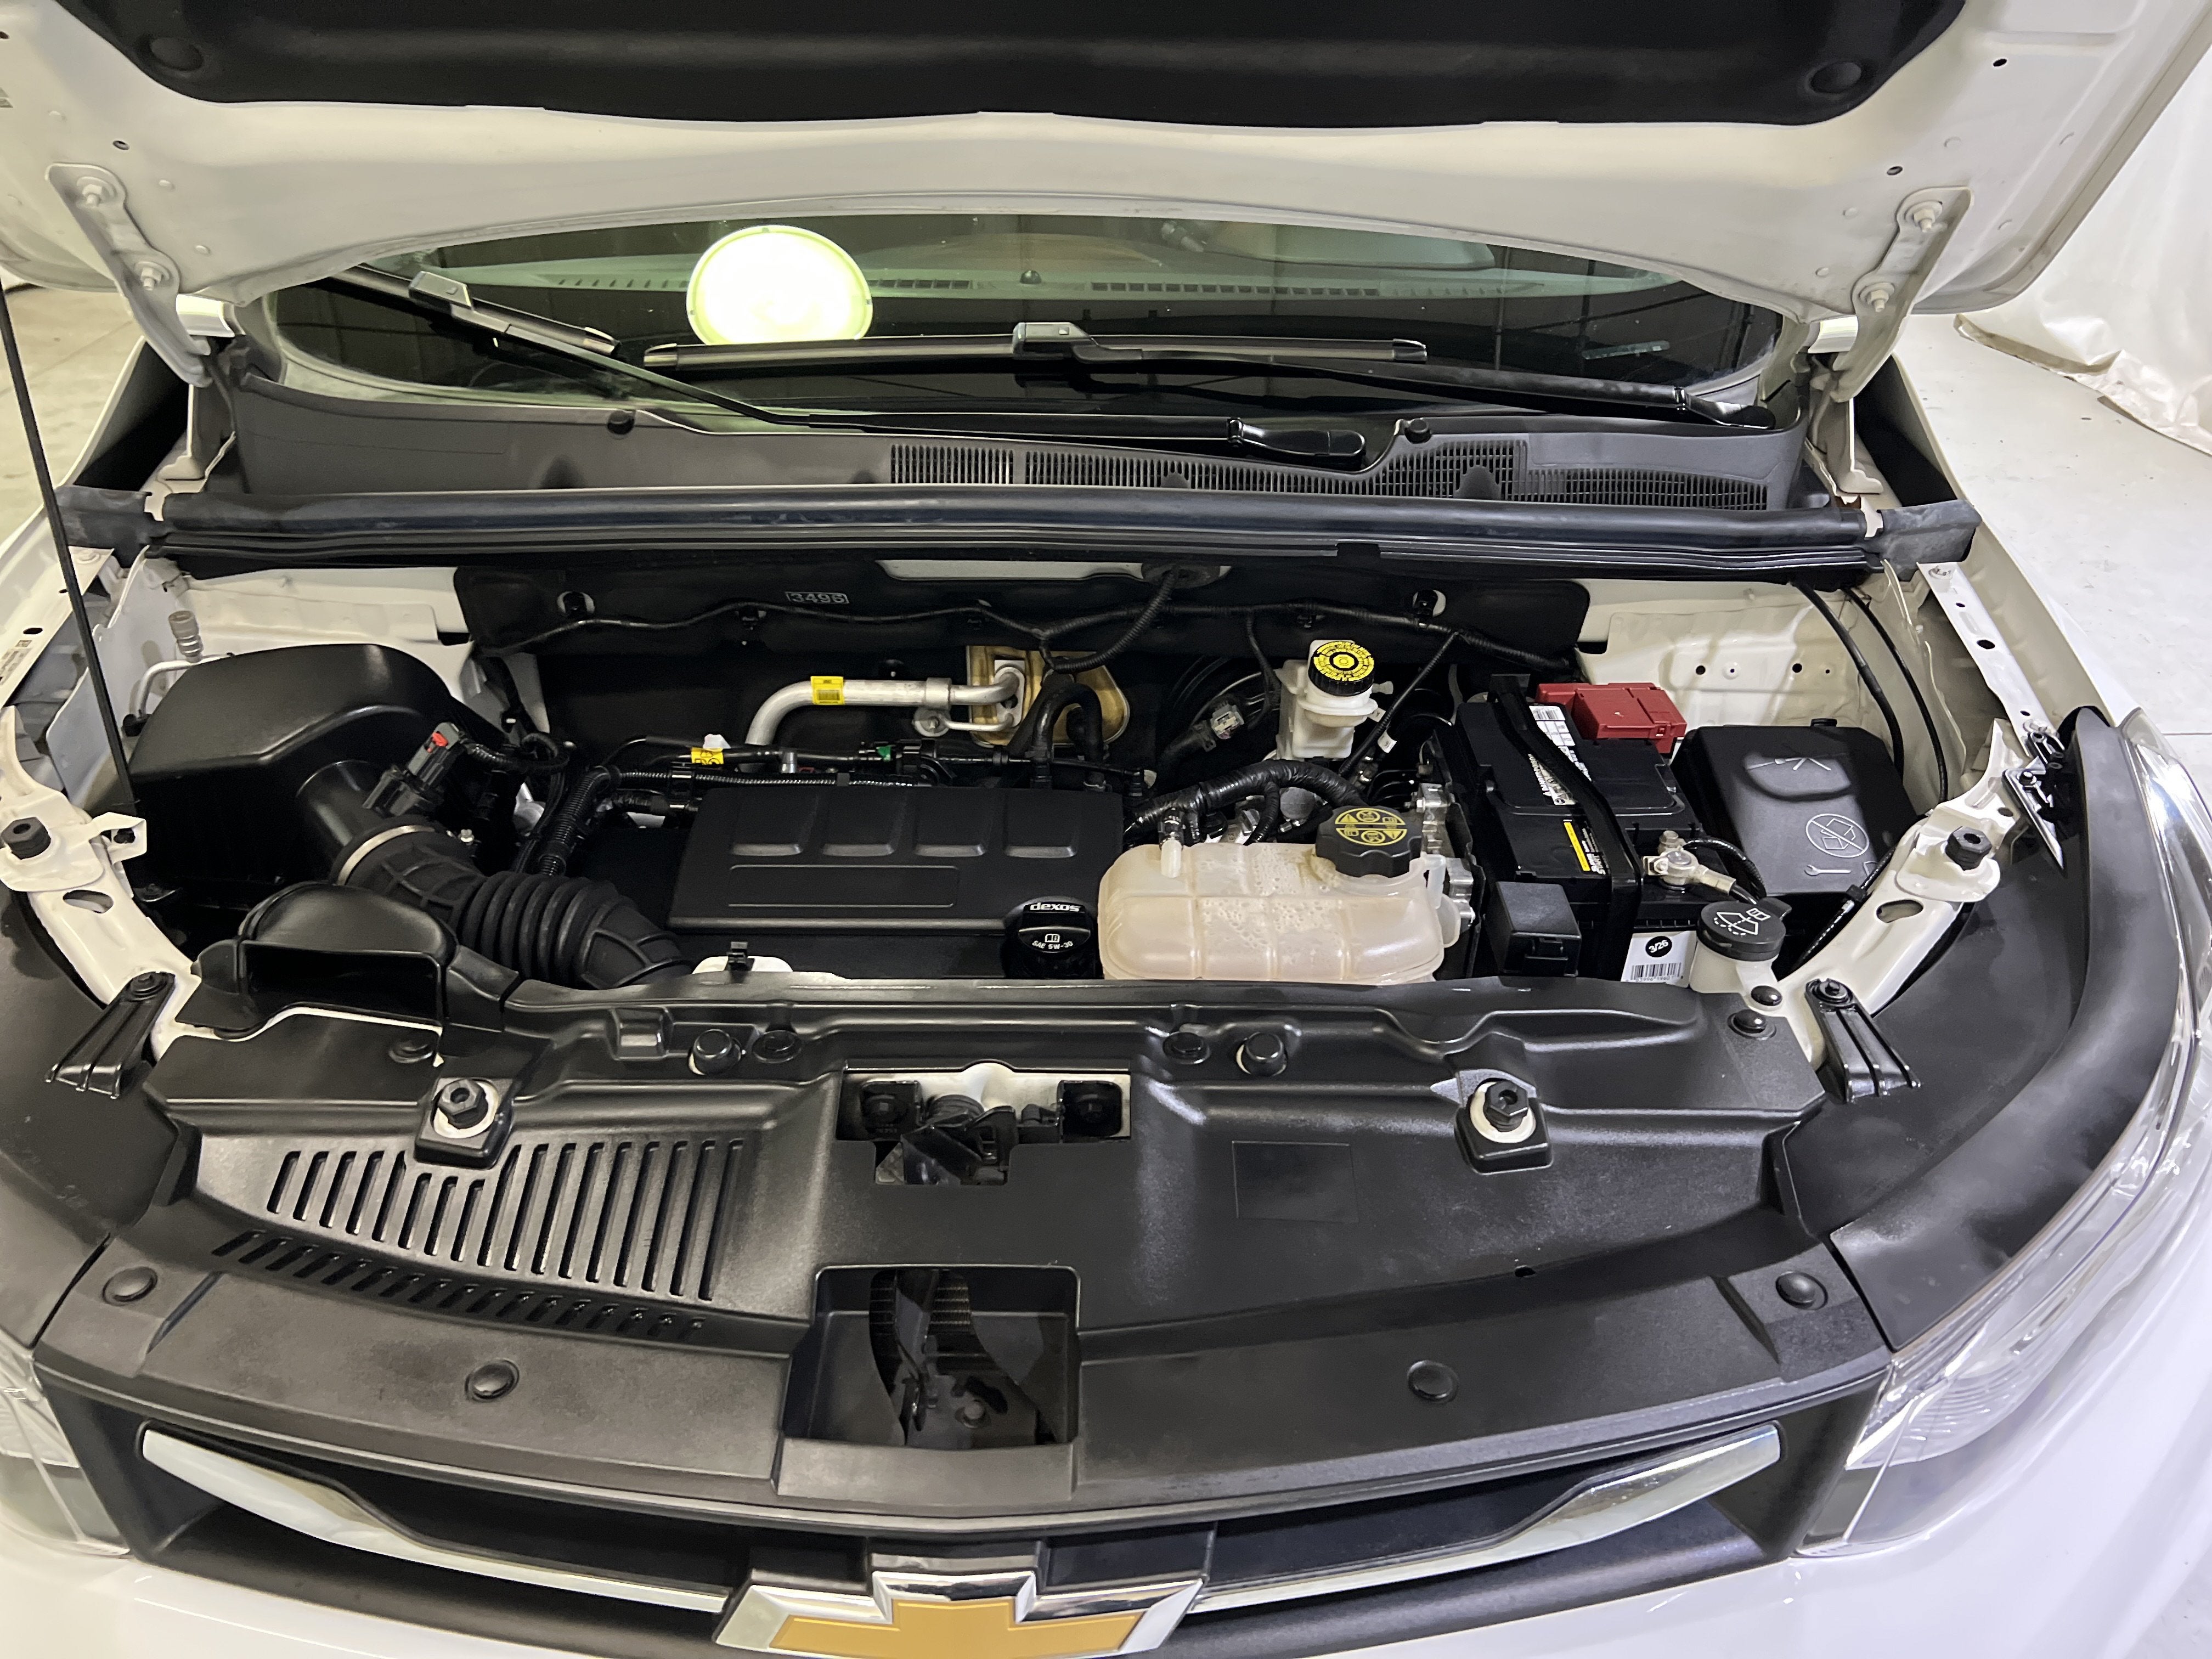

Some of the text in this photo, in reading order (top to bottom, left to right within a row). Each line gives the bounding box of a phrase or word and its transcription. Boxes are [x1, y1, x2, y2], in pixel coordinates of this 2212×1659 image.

[790, 592, 845, 603] 3496
[1030, 902, 1081, 912] dexos
[1031, 940, 1074, 950] SAE 5W-30
[1649, 939, 1669, 953] 3/26
